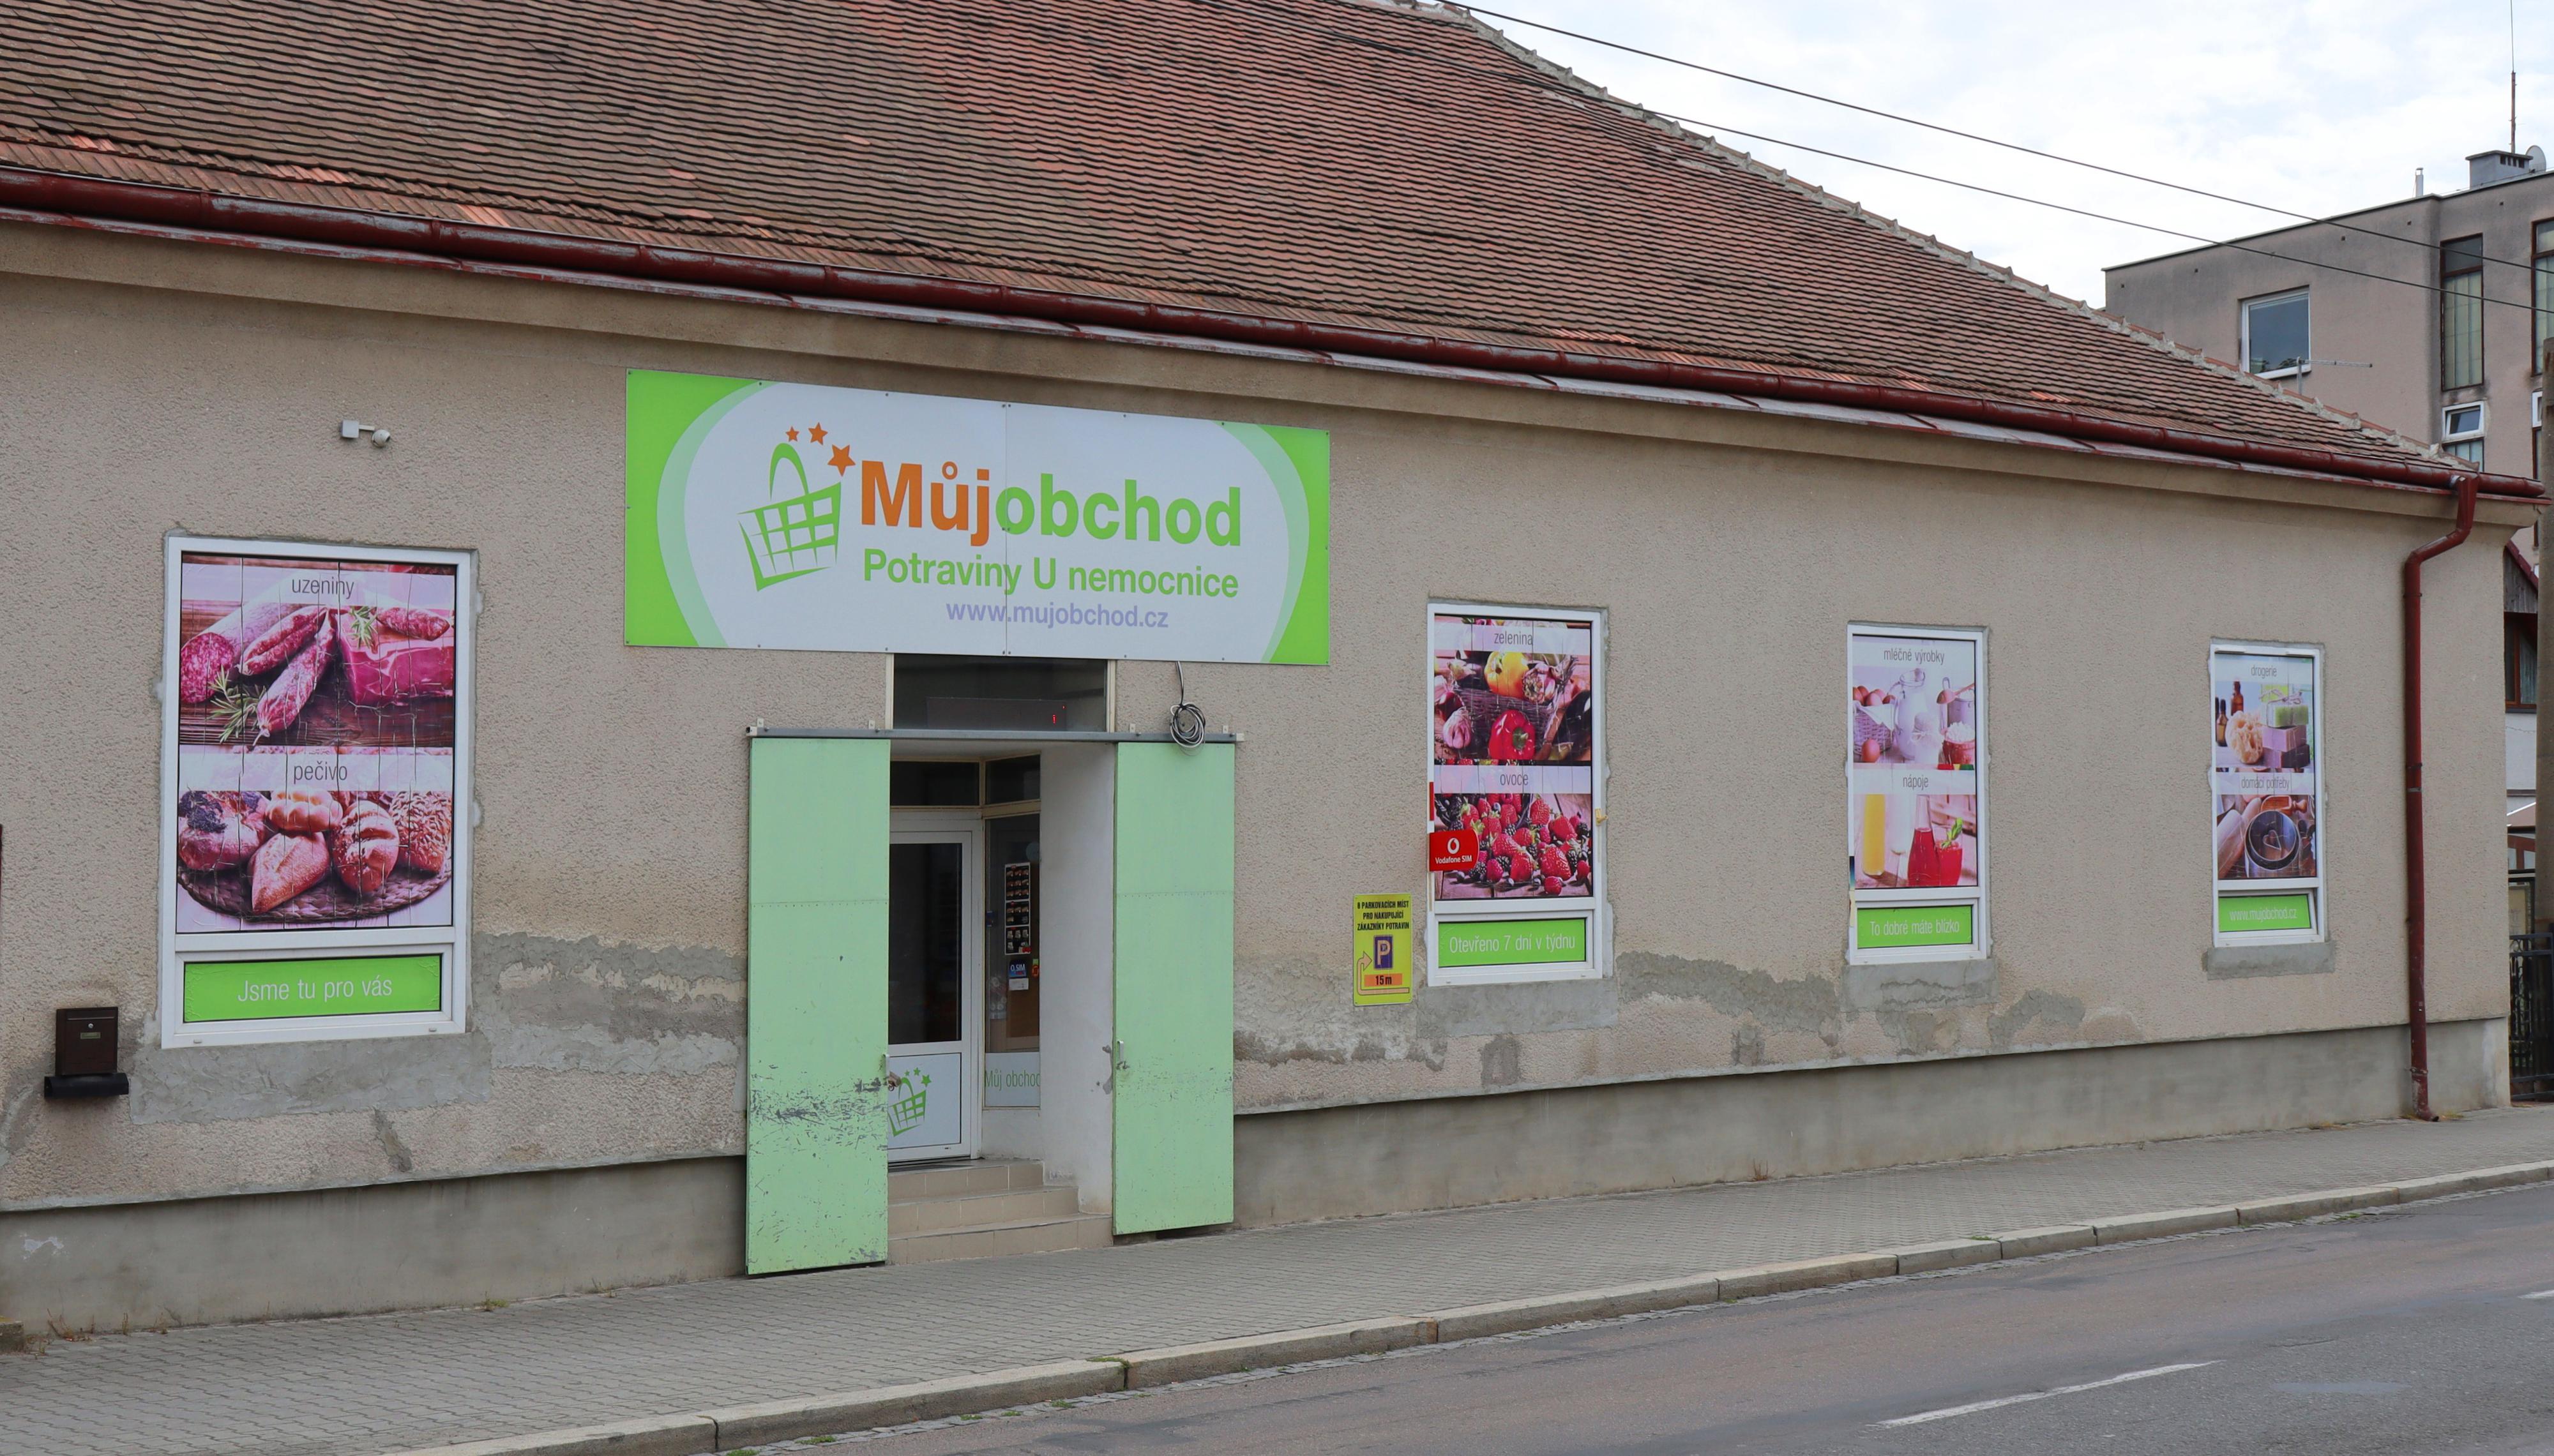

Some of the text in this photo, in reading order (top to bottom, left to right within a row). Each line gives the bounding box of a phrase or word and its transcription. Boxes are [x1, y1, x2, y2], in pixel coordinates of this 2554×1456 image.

[864, 548, 1239, 597] Potraviny U nemocnice
[292, 576, 354, 600] uzeniny
[946, 601, 1169, 629] www.mujobchod.cz
[1494, 631, 1533, 645] zelenina
[1884, 648, 1945, 665] mléčné výrobky
[2251, 664, 2277, 679] drogerie
[293, 760, 348, 784] pečivo
[1500, 774, 1529, 786] ovoce
[1903, 774, 1929, 791] nápoje
[2266, 776, 2290, 791] potřeby
[1361, 900, 1396, 909] PARKOVACÍCH
[1396, 899, 1409, 908] MÍST
[1374, 909, 1404, 919] NAKUPUJÍCÍ
[1357, 921, 1410, 931] ZÁKAZNÍKY POTRAVIN
[1870, 918, 1960, 936] To dobré máte blízko
[1449, 933, 1575, 954] Otevřeno 7 dní v týdnu
[1377, 940, 1391, 965] P
[238, 975, 392, 1002] Jsme tu pro vás
[985, 1069, 1001, 1092] Můj
